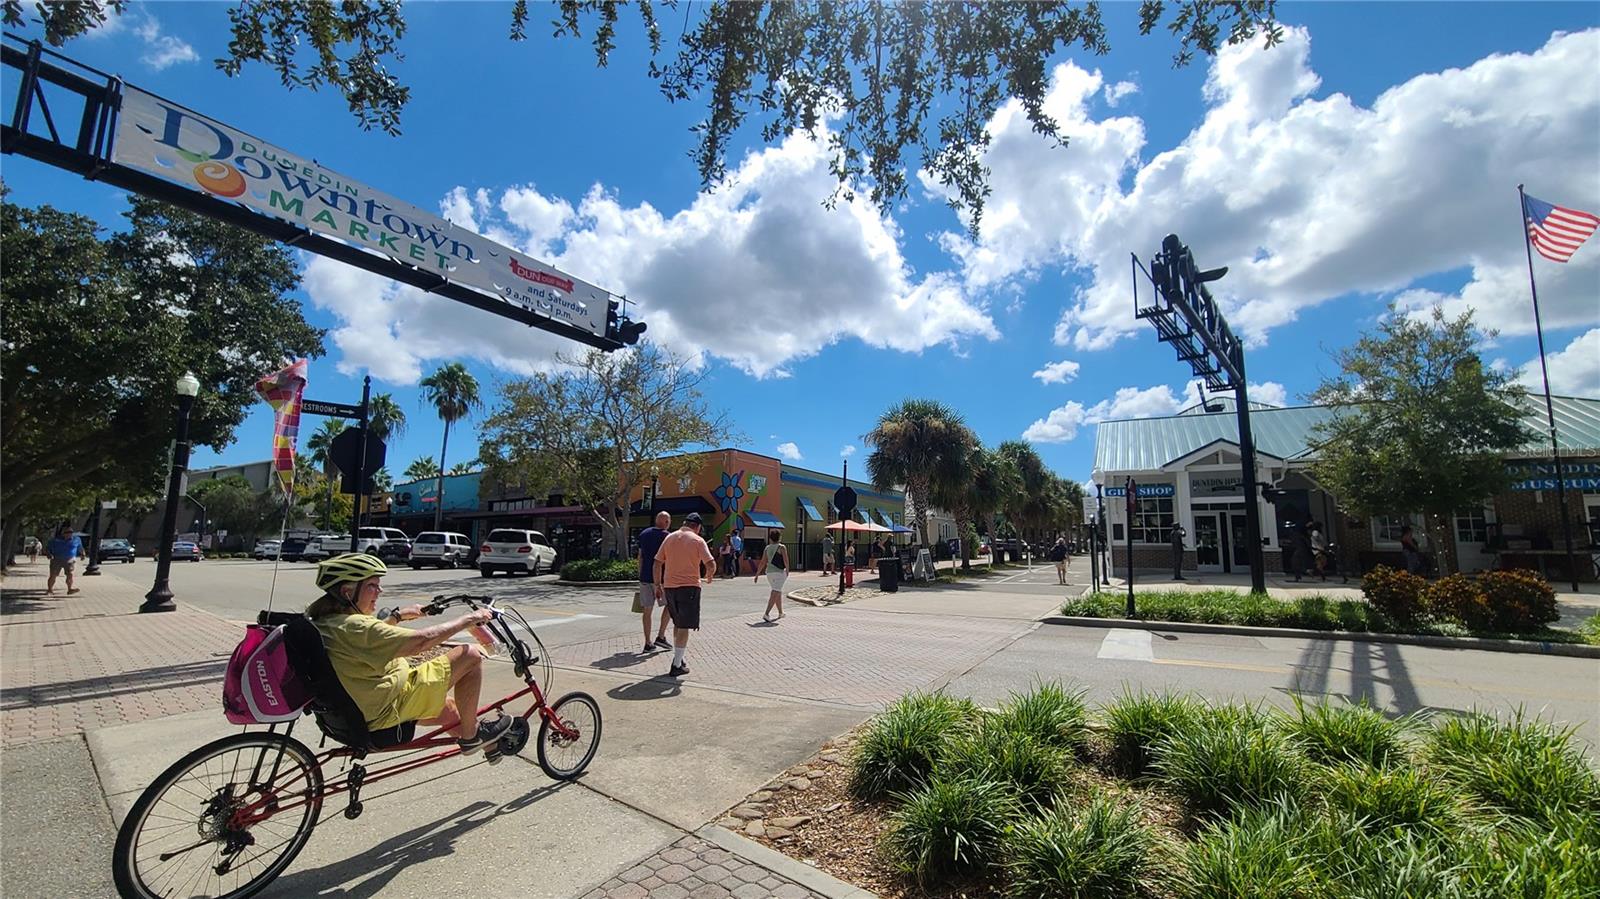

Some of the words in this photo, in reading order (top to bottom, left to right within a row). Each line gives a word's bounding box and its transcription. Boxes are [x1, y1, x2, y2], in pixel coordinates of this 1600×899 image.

[154, 103, 475, 264] Downtown
[241, 141, 359, 196] DUNEDIN
[269, 190, 450, 270] MARKET
[517, 268, 541, 281] DUN
[505, 286, 512, 296] 9
[513, 291, 534, 305] a.m.
[555, 308, 574, 321] p.m.
[527, 286, 545, 298] and
[547, 292, 588, 316] Saturdays
[303, 403, 337, 414] ESTROOMS
[1504, 463, 1600, 475] DNEDIN
[1139, 486, 1173, 496] SHOP
[256, 660, 279, 706] EASTON
